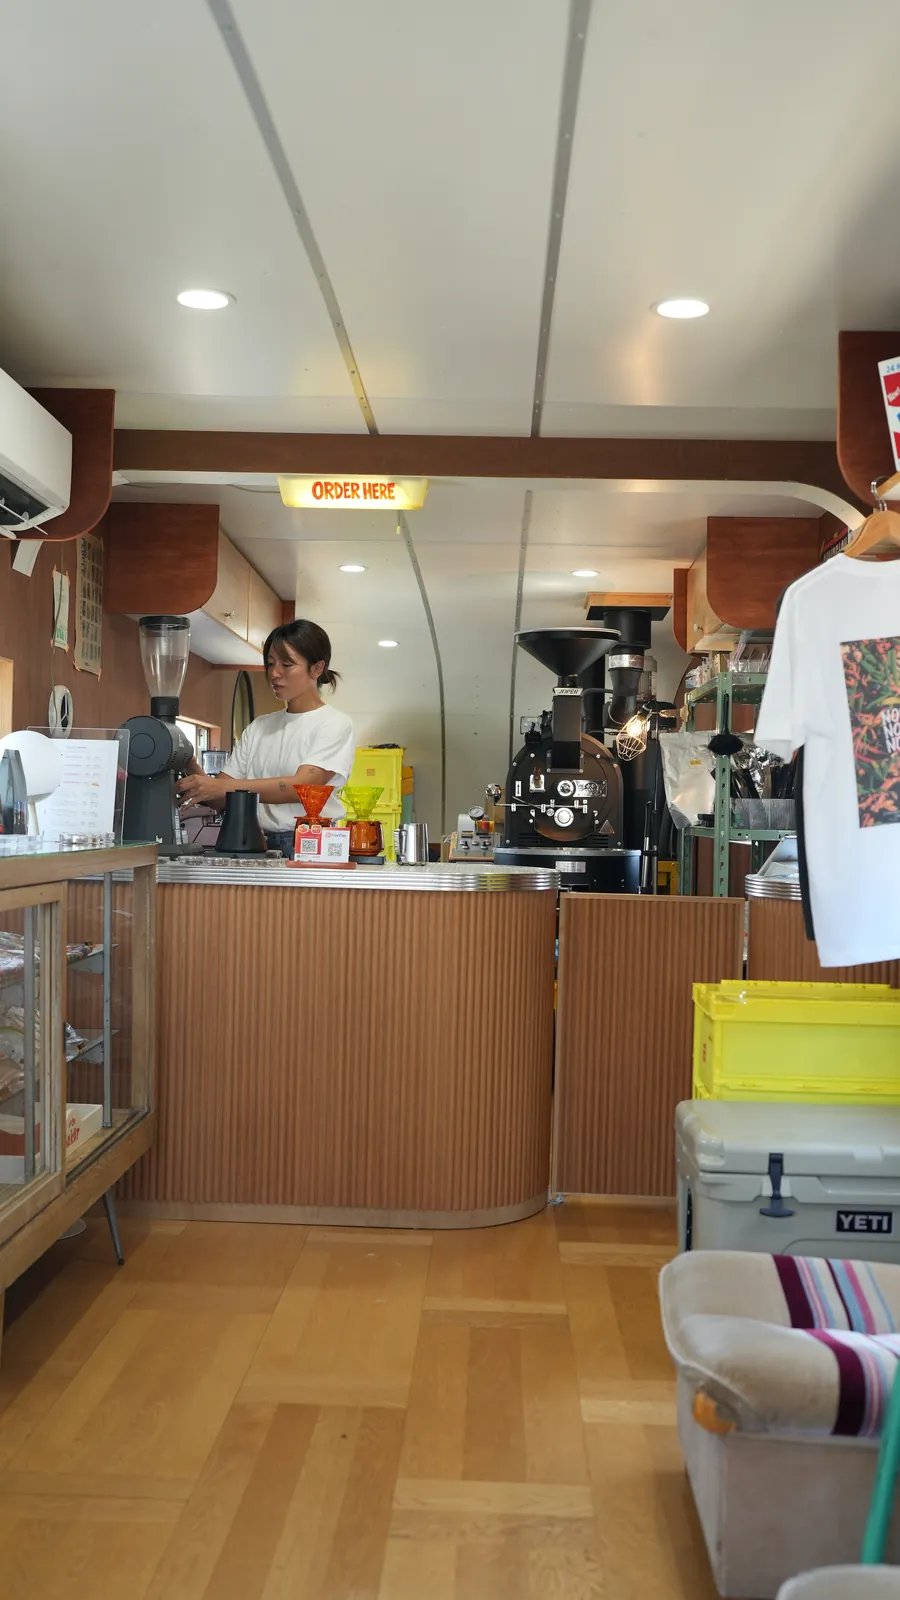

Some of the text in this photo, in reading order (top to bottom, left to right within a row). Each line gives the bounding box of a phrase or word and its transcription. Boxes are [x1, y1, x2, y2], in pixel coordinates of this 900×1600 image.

[312, 481, 395, 500] ORDER HERE
[882, 707, 900, 726] NO
[839, 1213, 889, 1230] YETI
